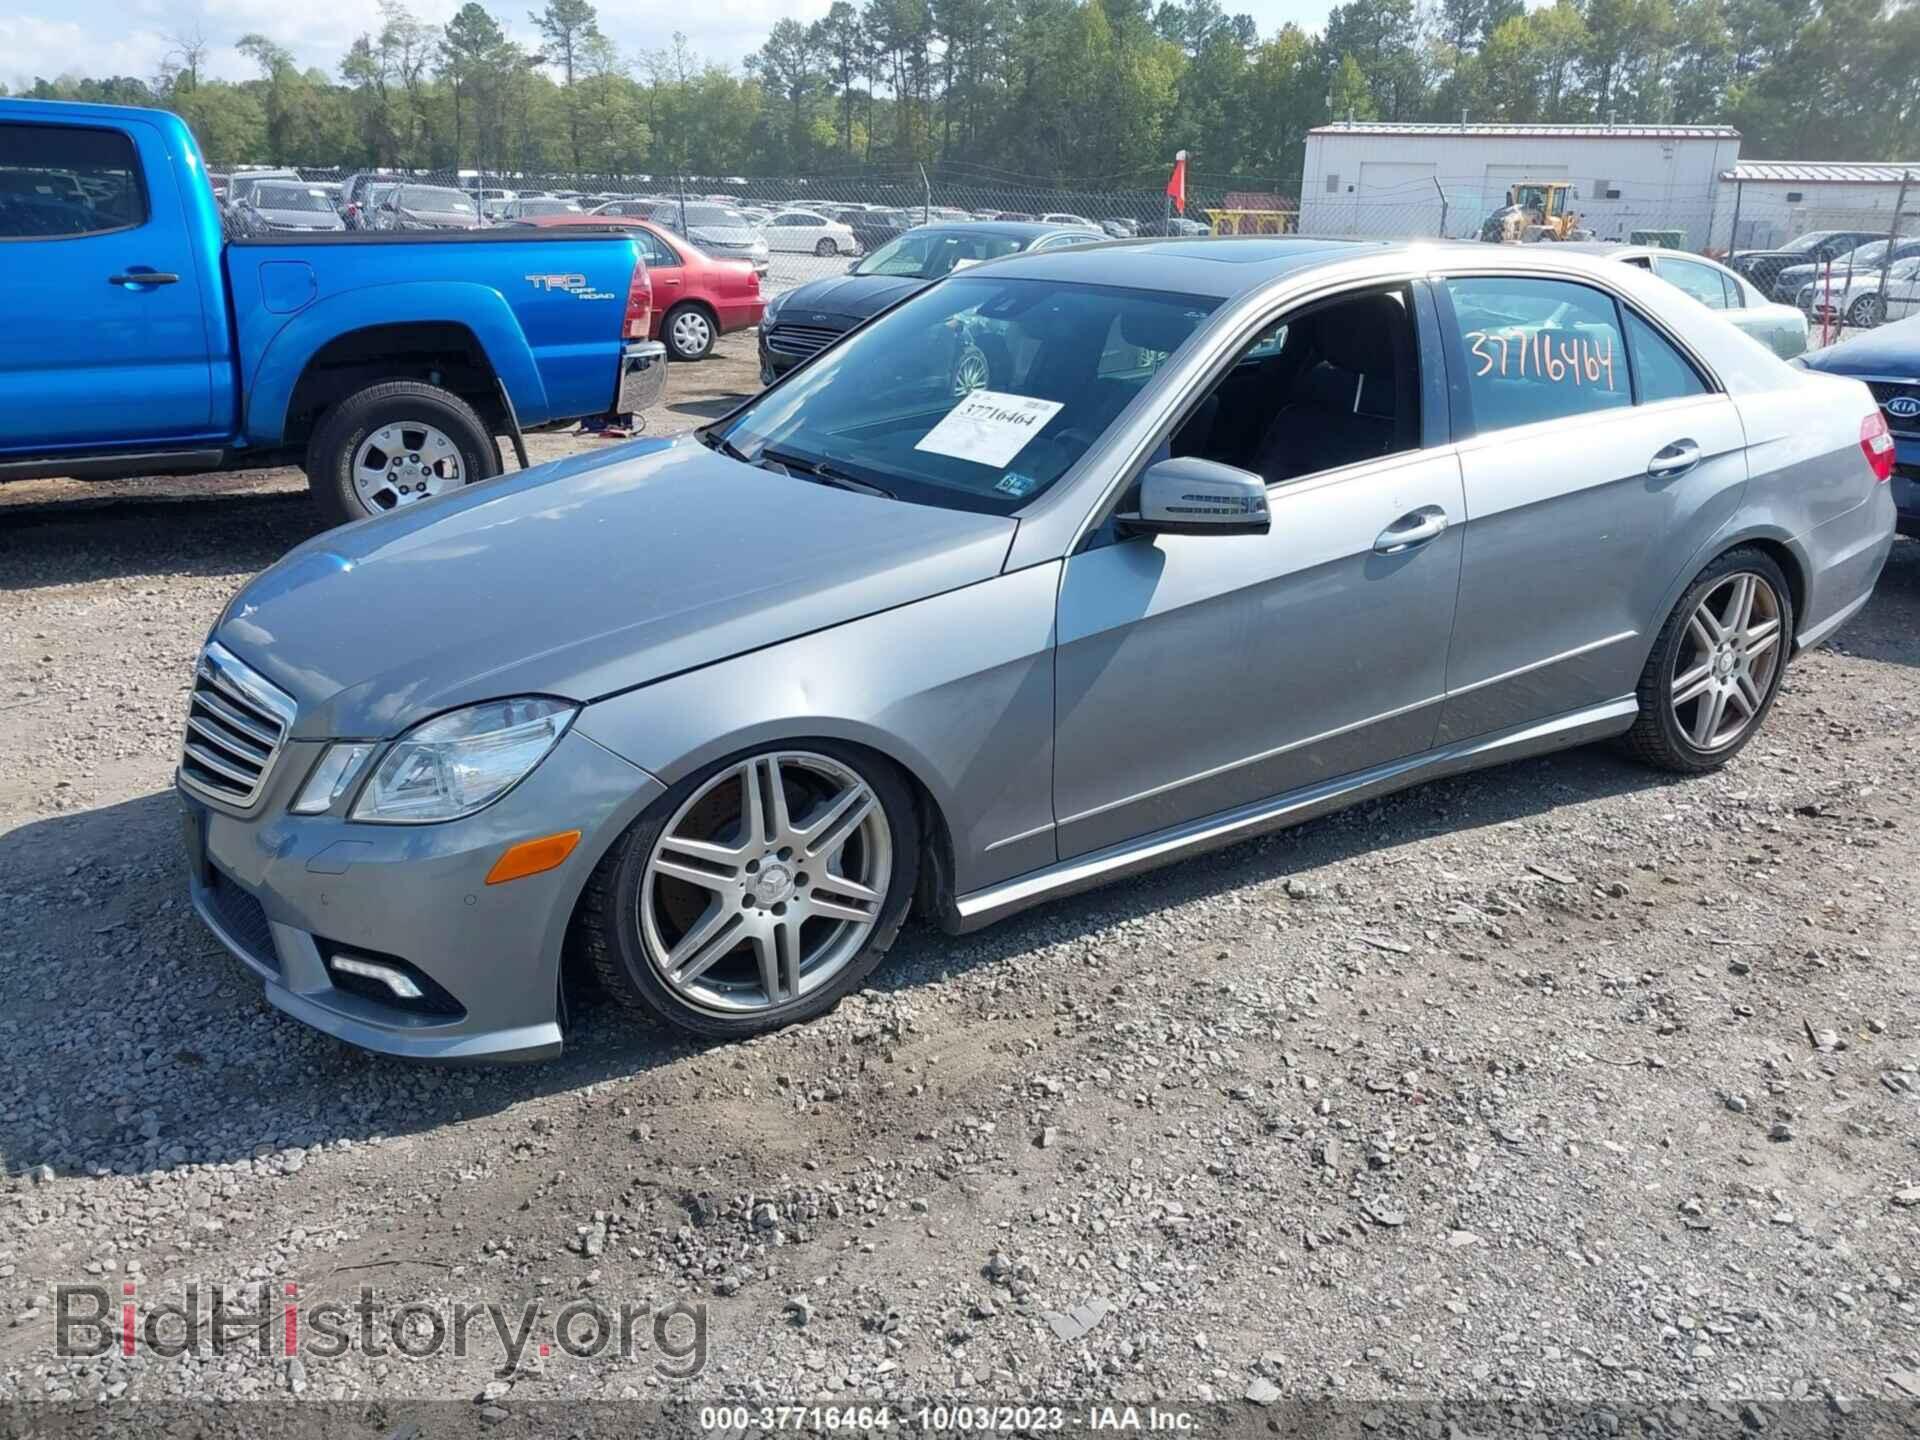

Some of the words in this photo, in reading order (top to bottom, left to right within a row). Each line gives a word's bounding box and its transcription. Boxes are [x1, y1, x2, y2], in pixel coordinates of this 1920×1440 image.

[525, 273, 586, 291] TRD
[1465, 331, 1613, 391] 37716464
[960, 403, 1037, 426] 37716464
[1892, 401, 1917, 412] KIA
